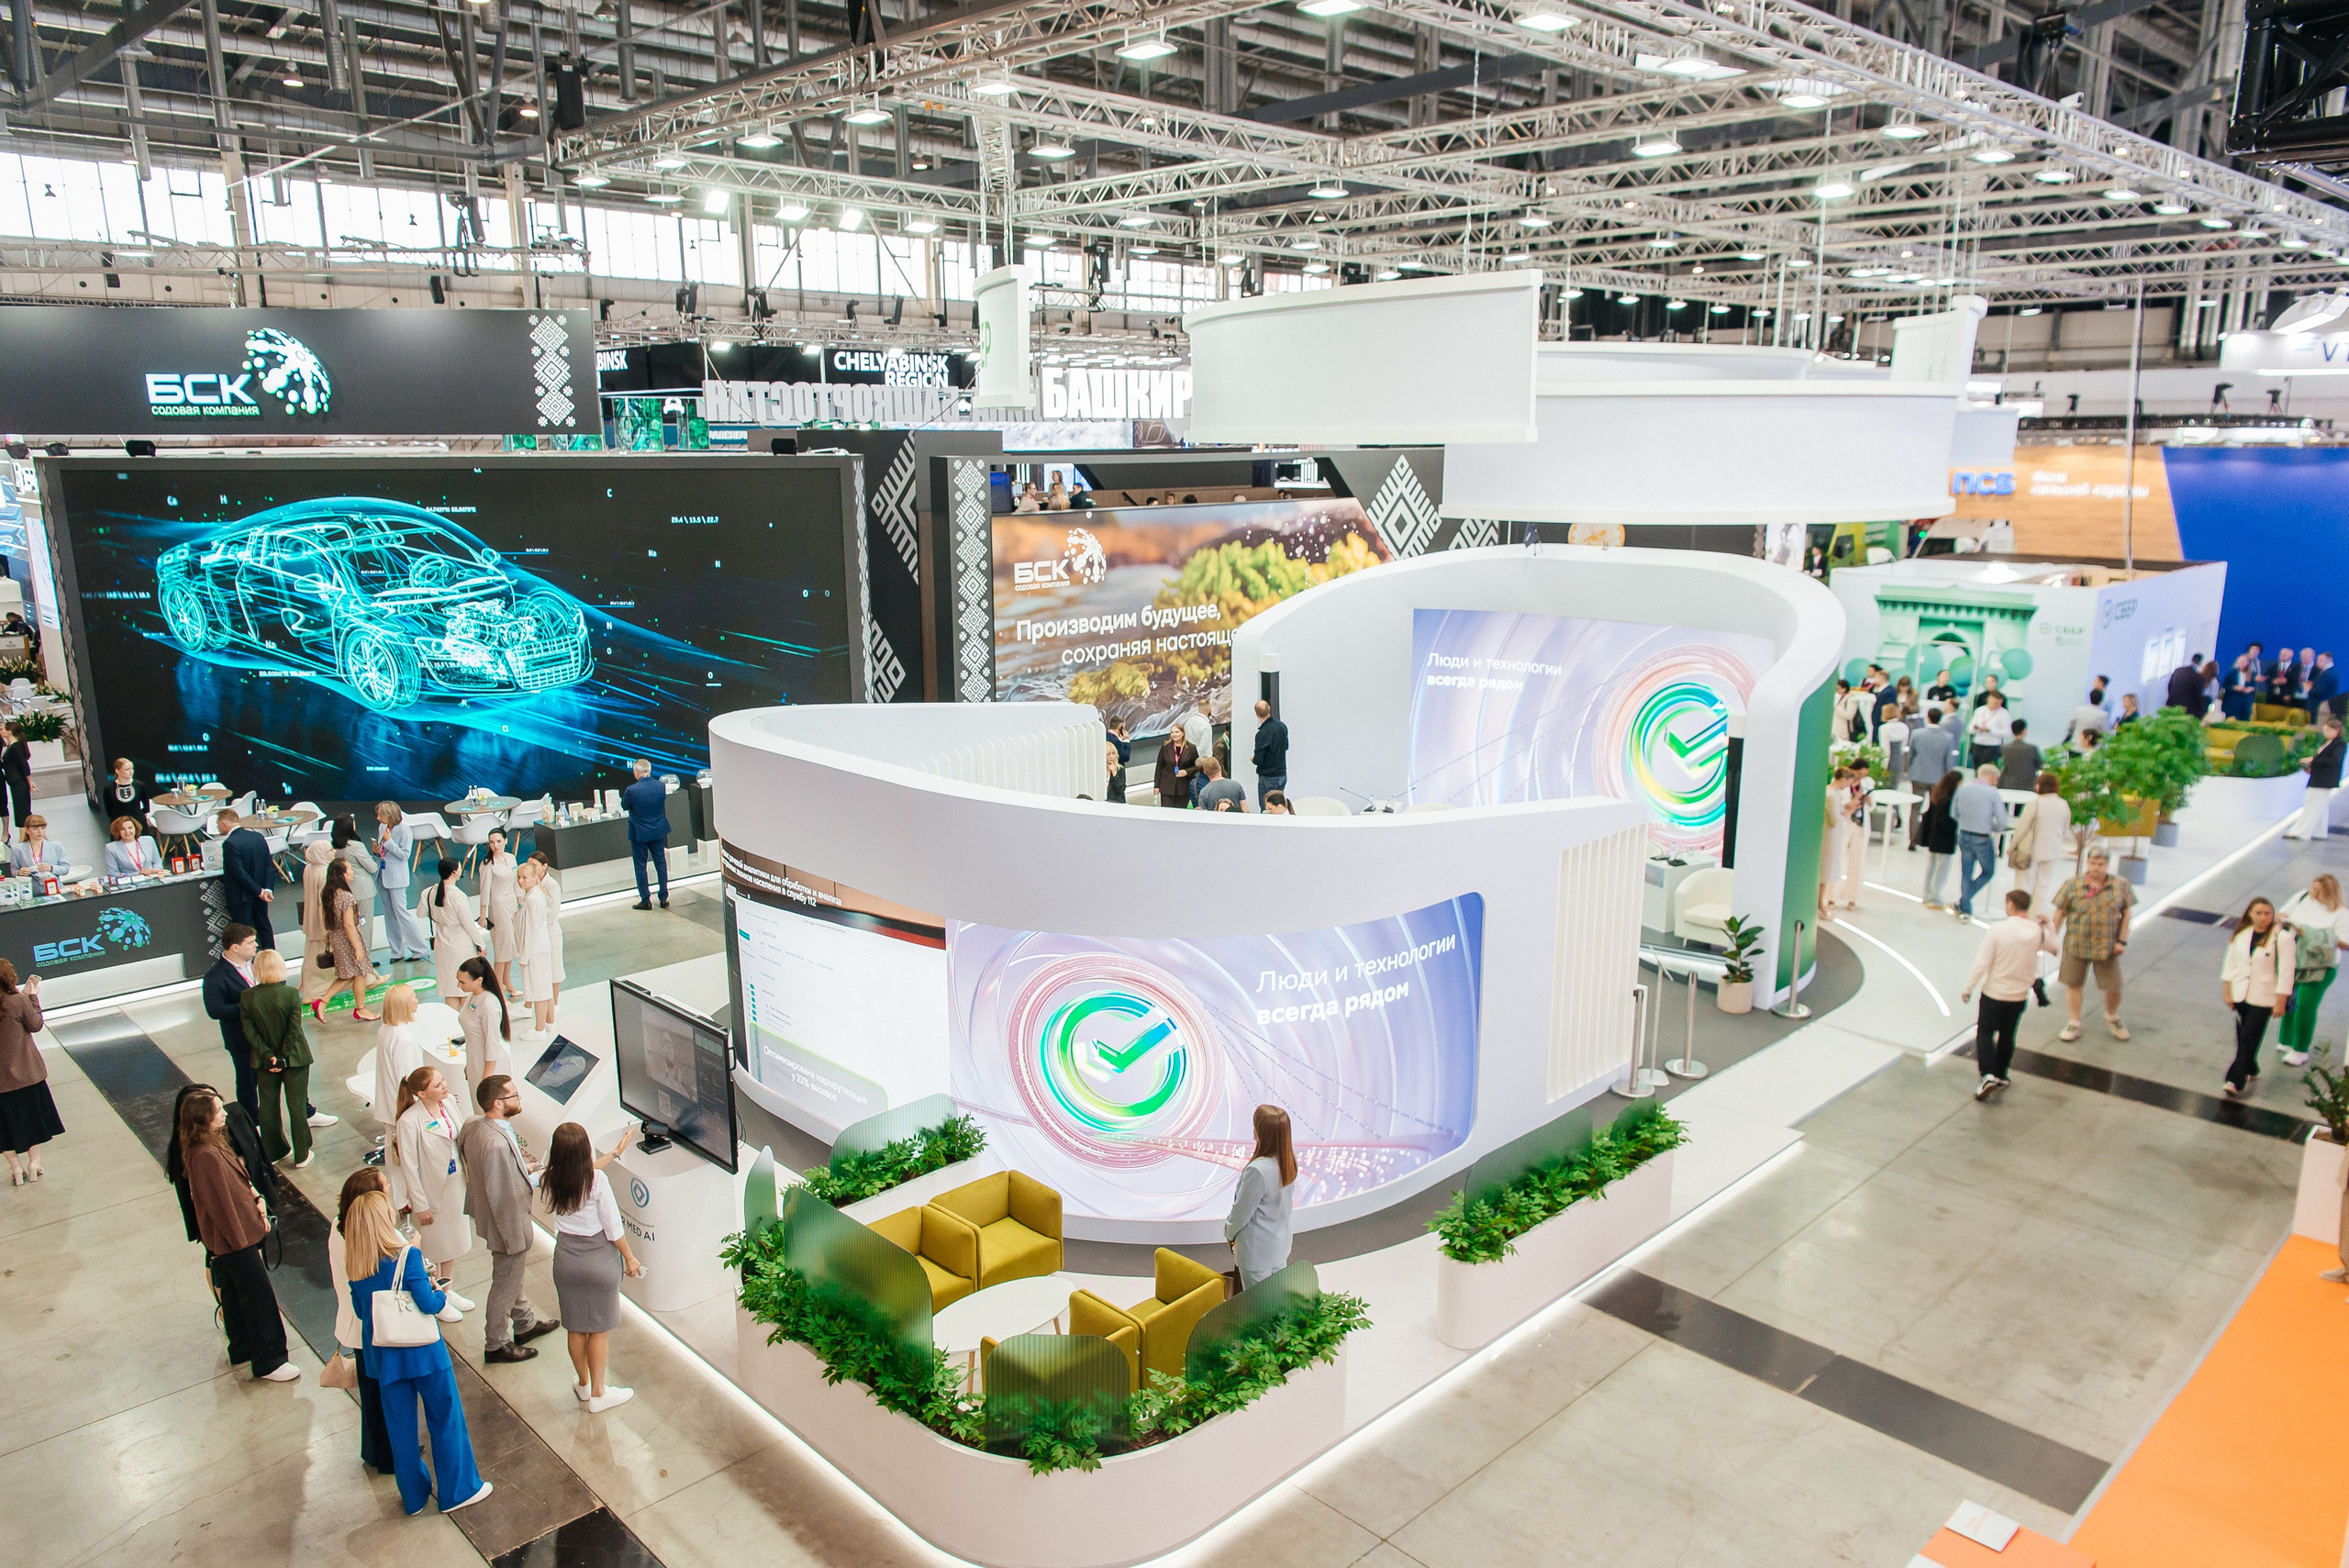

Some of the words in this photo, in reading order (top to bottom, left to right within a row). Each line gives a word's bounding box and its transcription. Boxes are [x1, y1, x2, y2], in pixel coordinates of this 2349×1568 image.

[834, 350, 950, 373] CHELYABINSK
[145, 373, 257, 405] БСК
[885, 372, 949, 389] REGION
[1042, 367, 1193, 418] БАШКИР
[151, 406, 201, 416] содовая
[202, 406, 260, 416] компания
[1952, 472, 2016, 495] ПСБ
[1014, 559, 1070, 584] БСК
[1017, 611, 1137, 645] Производим
[1141, 603, 1221, 630] будущее,
[1062, 638, 1152, 666] сохраняя
[1426, 652, 1469, 669] Люди
[1473, 658, 1481, 668] и
[1486, 658, 1563, 676] технологии
[1427, 674, 1475, 688] всегда
[1479, 677, 1524, 691] рядом
[782, 877, 812, 895] обработки
[818, 891, 842, 906] анализа
[786, 887, 807, 905] службу
[807, 895, 817, 907] 112
[33, 934, 106, 962] БСК
[1256, 969, 1328, 994] Люди
[1335, 965, 1348, 984] и
[1354, 933, 1456, 979] технологии
[1256, 999, 1339, 1026] всегда
[1344, 981, 1409, 1018] рядом
[763, 1045, 816, 1079] Оптимизирована
[816, 1073, 868, 1106] маршрутизация
[796, 1073, 809, 1088] 23%
[627, 1219, 641, 1238] MED
[643, 1231, 655, 1241] AI
